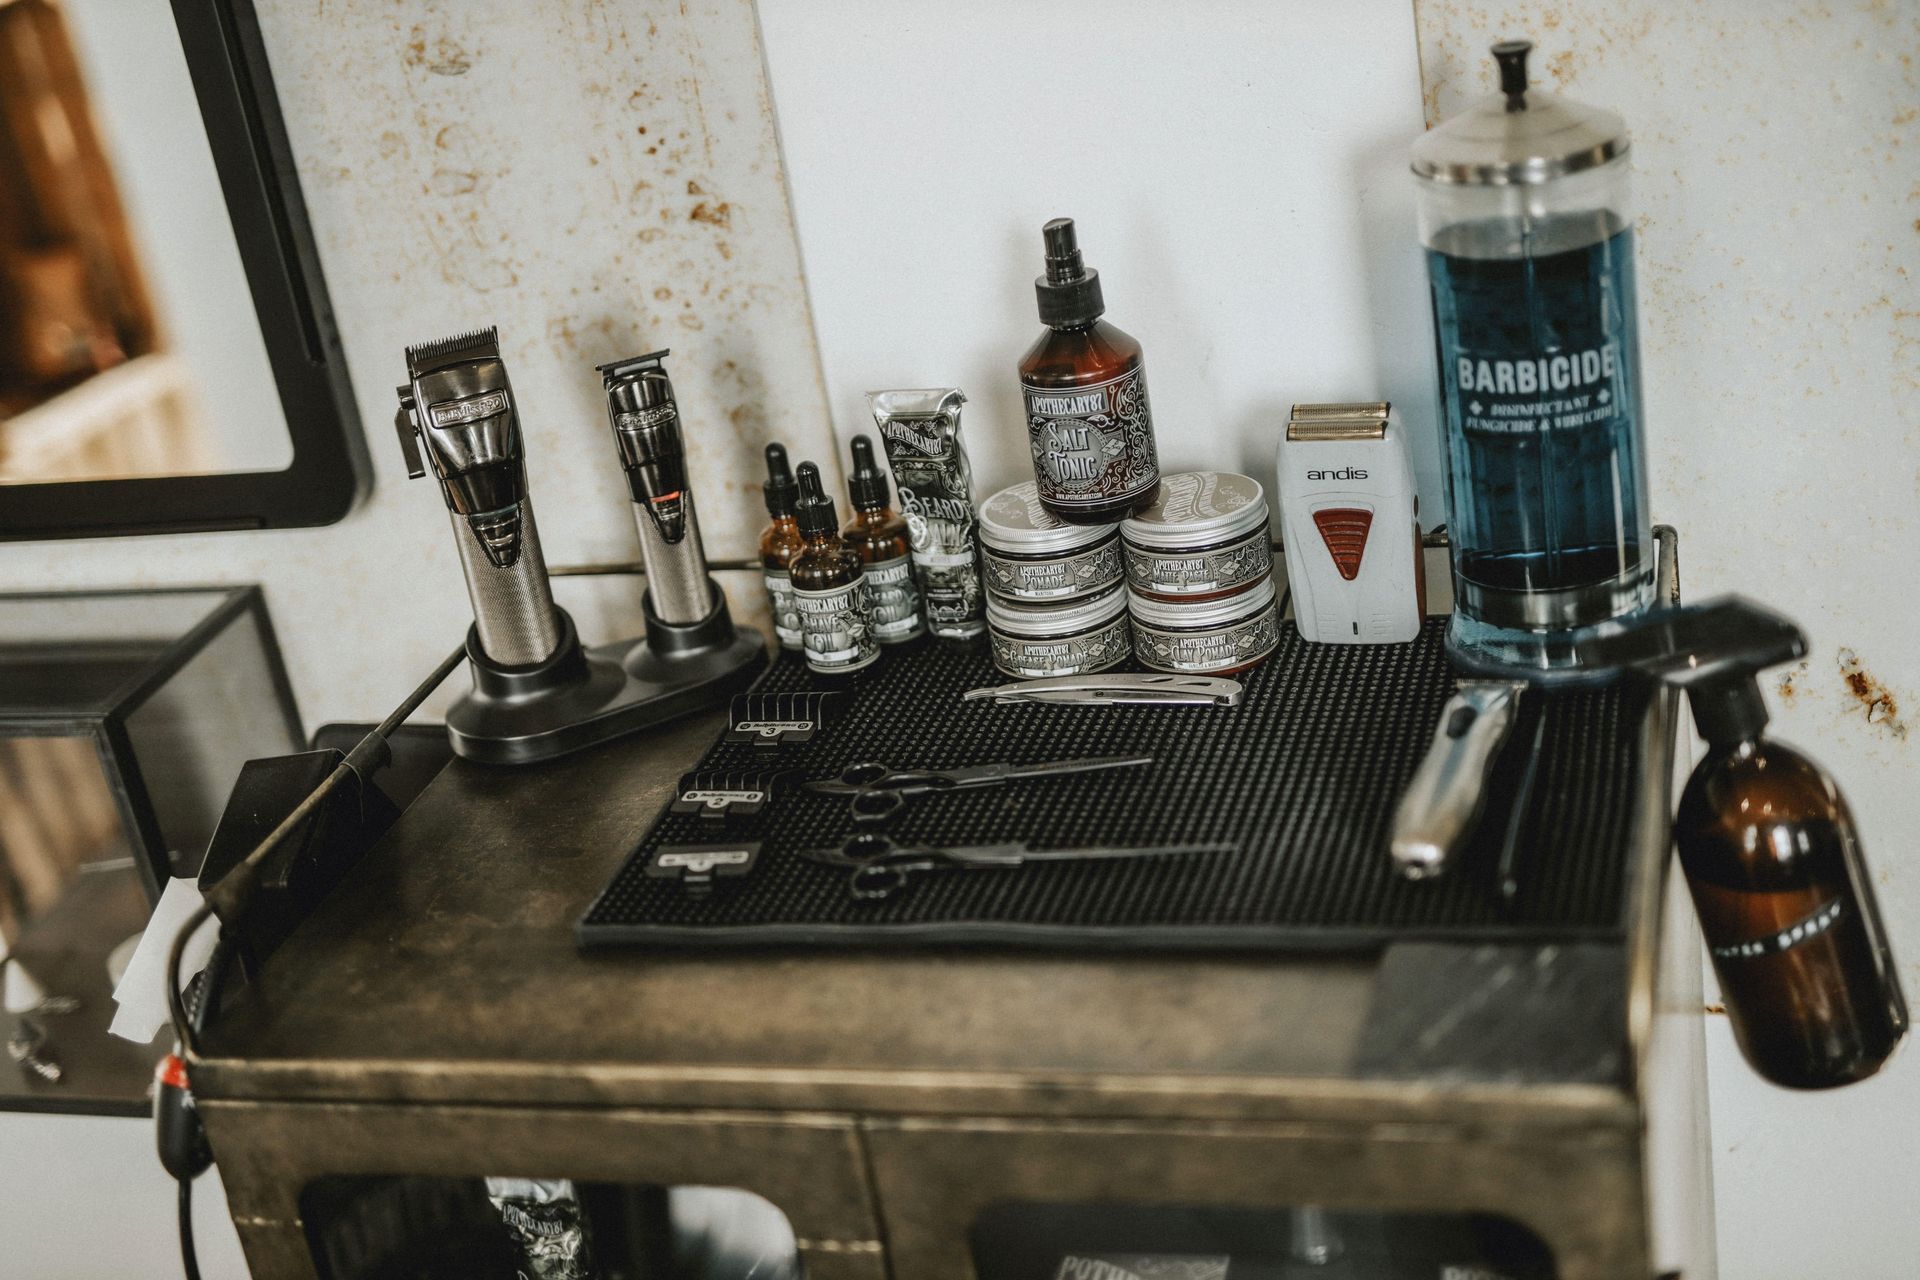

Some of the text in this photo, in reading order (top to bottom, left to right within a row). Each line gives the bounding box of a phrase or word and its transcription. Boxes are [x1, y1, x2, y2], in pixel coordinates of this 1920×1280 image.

[1458, 343, 1615, 394] BARBICIDE
[1031, 393, 1103, 415] APOTHECARY87
[887, 421, 943, 455] APOTHECARY87
[1048, 422, 1089, 453] SALT
[1049, 451, 1098, 484] TONIC
[1307, 467, 1368, 480] andis
[899, 487, 965, 524] BEARD
[1155, 559, 1204, 571] APOTHECARY87
[1023, 572, 1066, 592] POMADE
[801, 612, 841, 633] SHAVE
[812, 634, 838, 653] OIL
[1180, 635, 1227, 649] APOTHECARY87
[1171, 643, 1237, 665] CLAY POMADE
